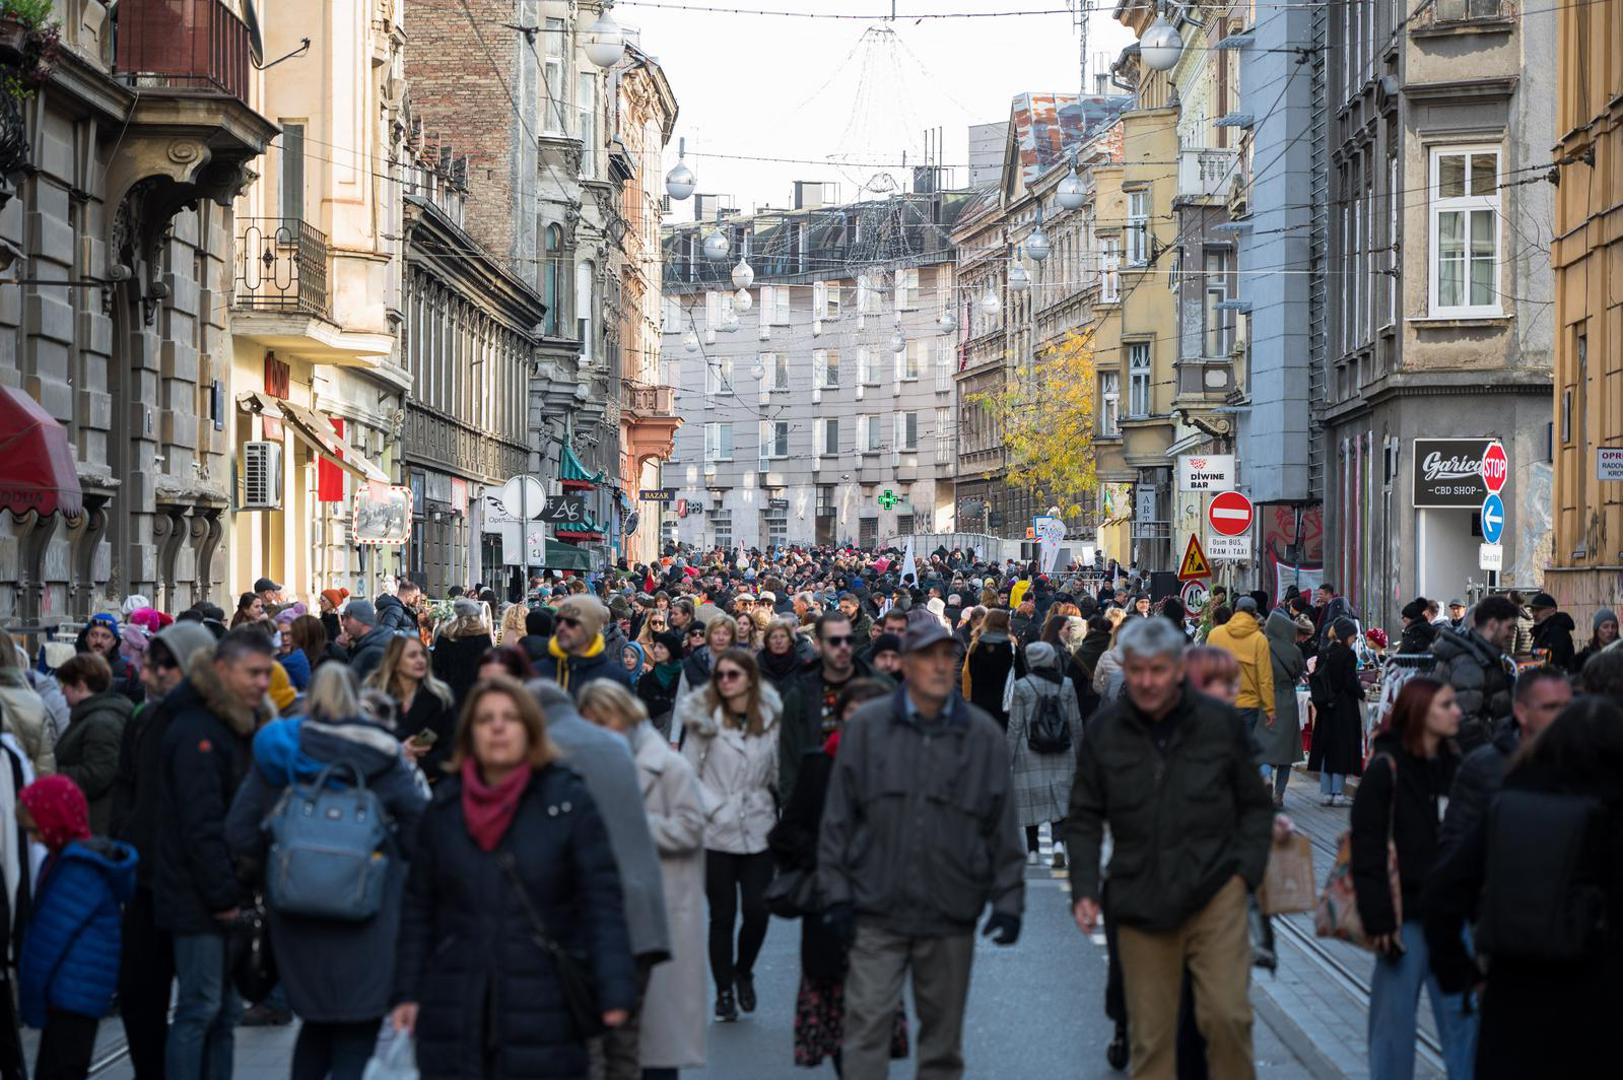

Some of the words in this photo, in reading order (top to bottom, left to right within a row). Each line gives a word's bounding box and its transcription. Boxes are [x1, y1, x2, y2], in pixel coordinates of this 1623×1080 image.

[1485, 458, 1506, 478] STOP
[1190, 481, 1209, 489] BAR
[1434, 486, 1452, 495] CBD
[1453, 486, 1477, 495] SHOP
[552, 499, 580, 521] Ag
[1187, 589, 1203, 607] 40
